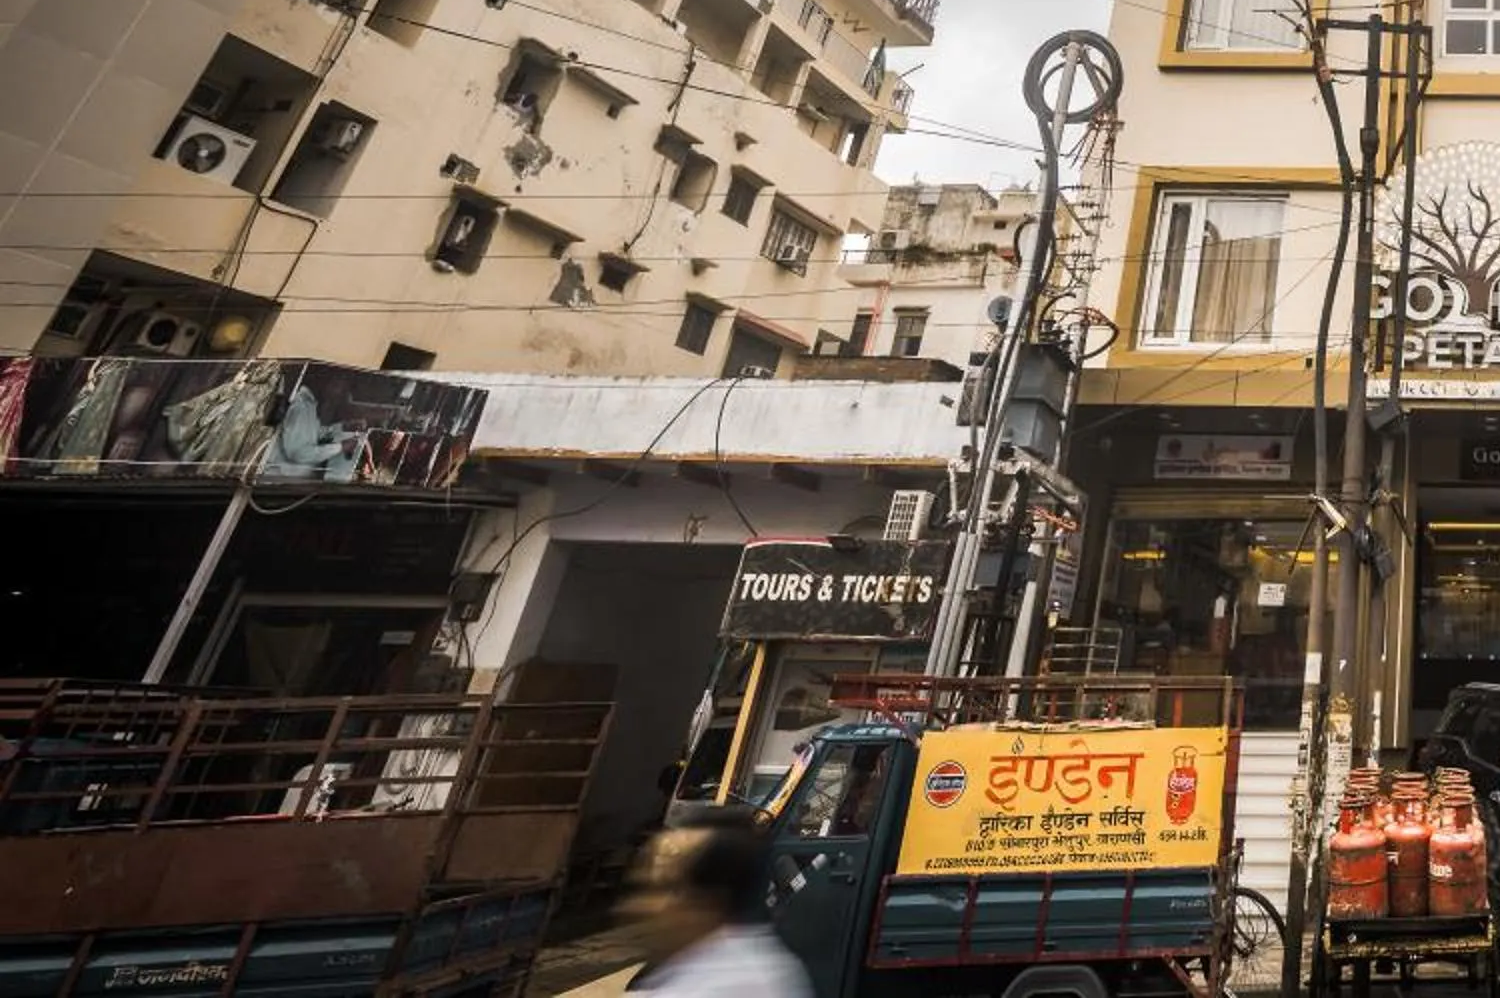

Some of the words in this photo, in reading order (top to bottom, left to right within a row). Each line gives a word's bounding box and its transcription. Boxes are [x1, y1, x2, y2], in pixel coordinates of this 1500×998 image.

[740, 572, 813, 602] TOURS
[817, 573, 834, 602] &
[842, 575, 934, 603] TICKETS
